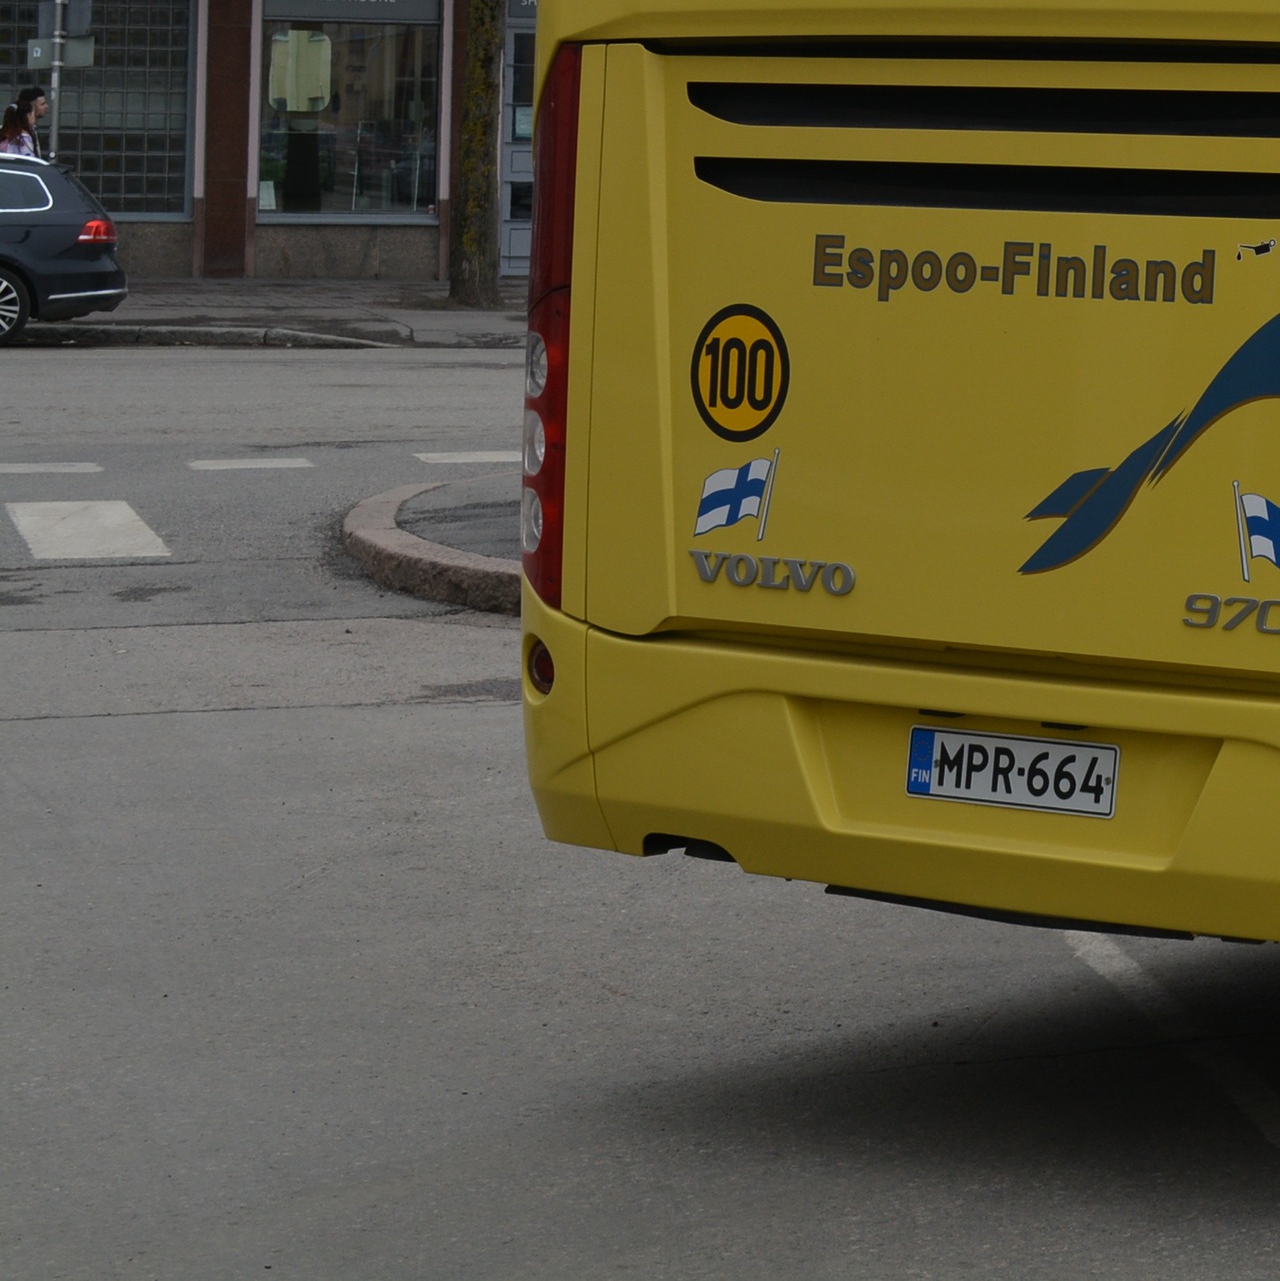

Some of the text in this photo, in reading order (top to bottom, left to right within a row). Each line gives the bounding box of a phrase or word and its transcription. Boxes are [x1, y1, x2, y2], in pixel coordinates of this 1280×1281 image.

[812, 233, 1217, 305] Espoo-Finland
[703, 336, 775, 414] 100
[689, 549, 856, 597] VOLVO
[911, 768, 930, 783] FIN
[937, 741, 1104, 804] MPR-664
